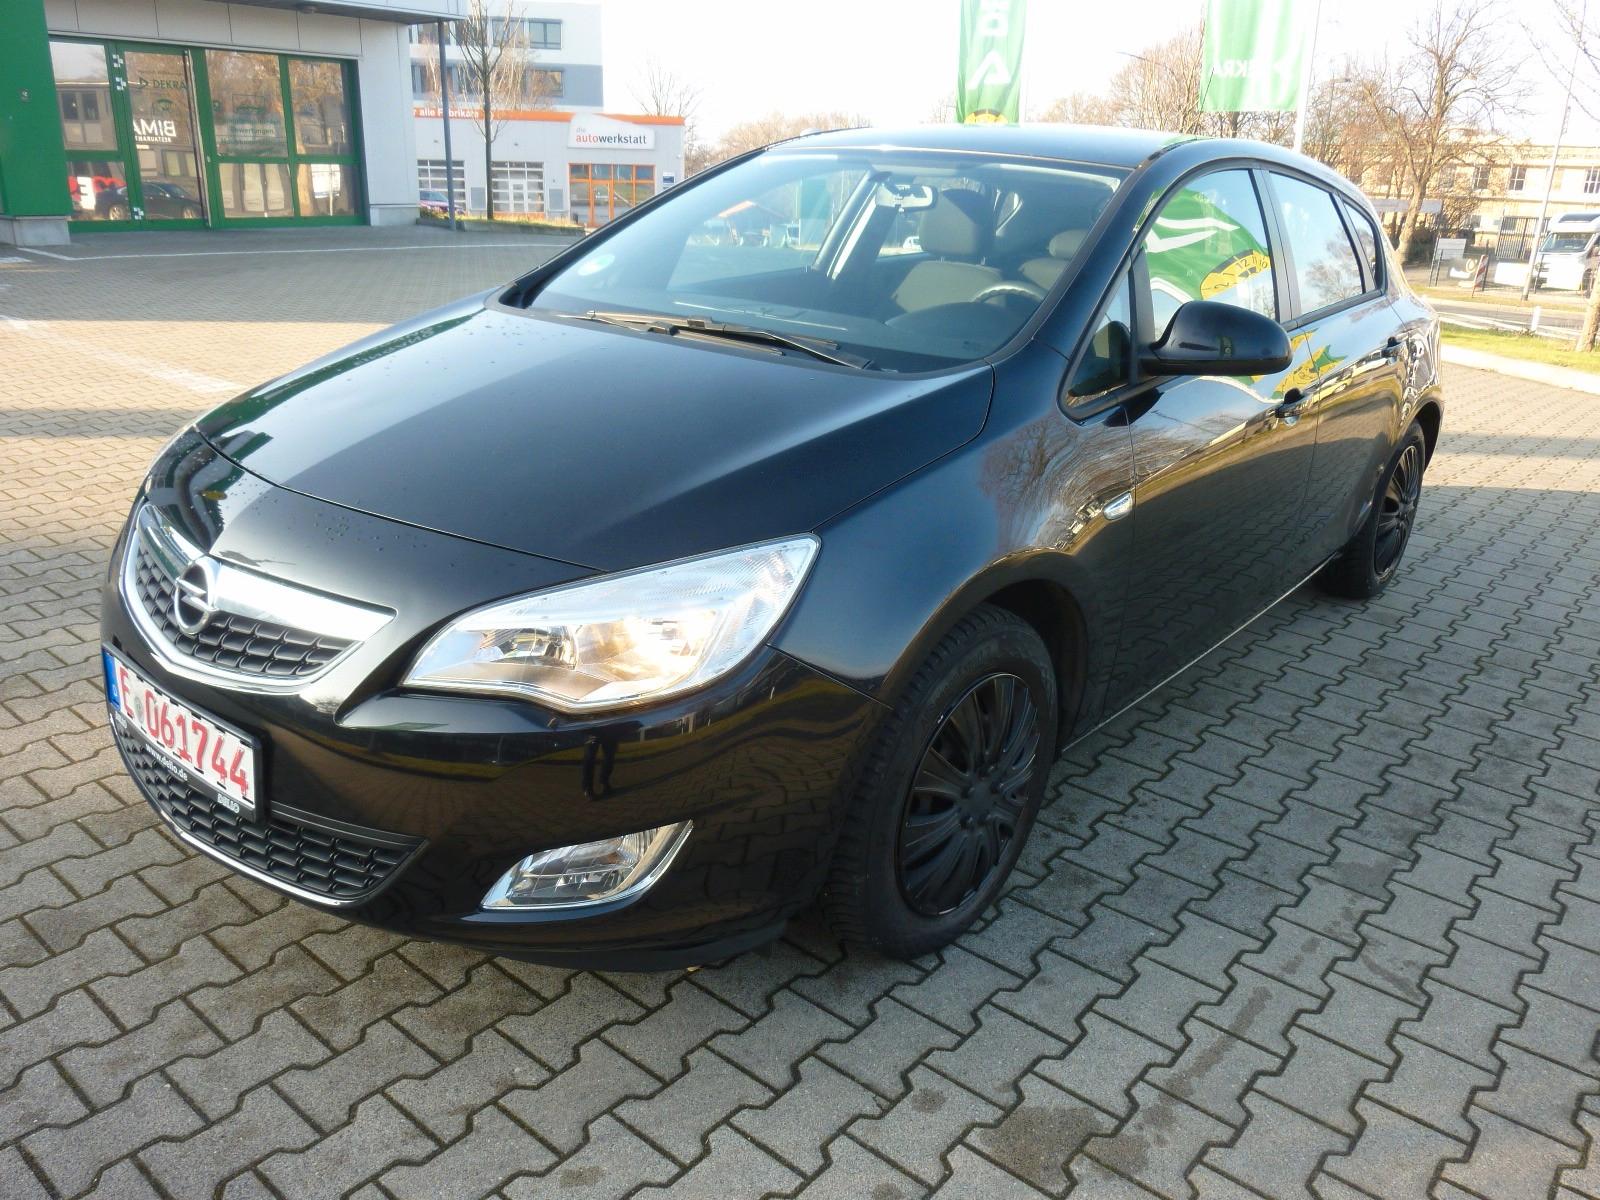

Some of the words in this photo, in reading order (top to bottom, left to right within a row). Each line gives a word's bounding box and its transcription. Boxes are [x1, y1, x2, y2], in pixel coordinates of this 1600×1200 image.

[153, 79, 188, 90] DEKRA
[576, 133, 647, 145] autowerkstatt
[119, 666, 134, 717] E
[145, 690, 249, 796] 061744
